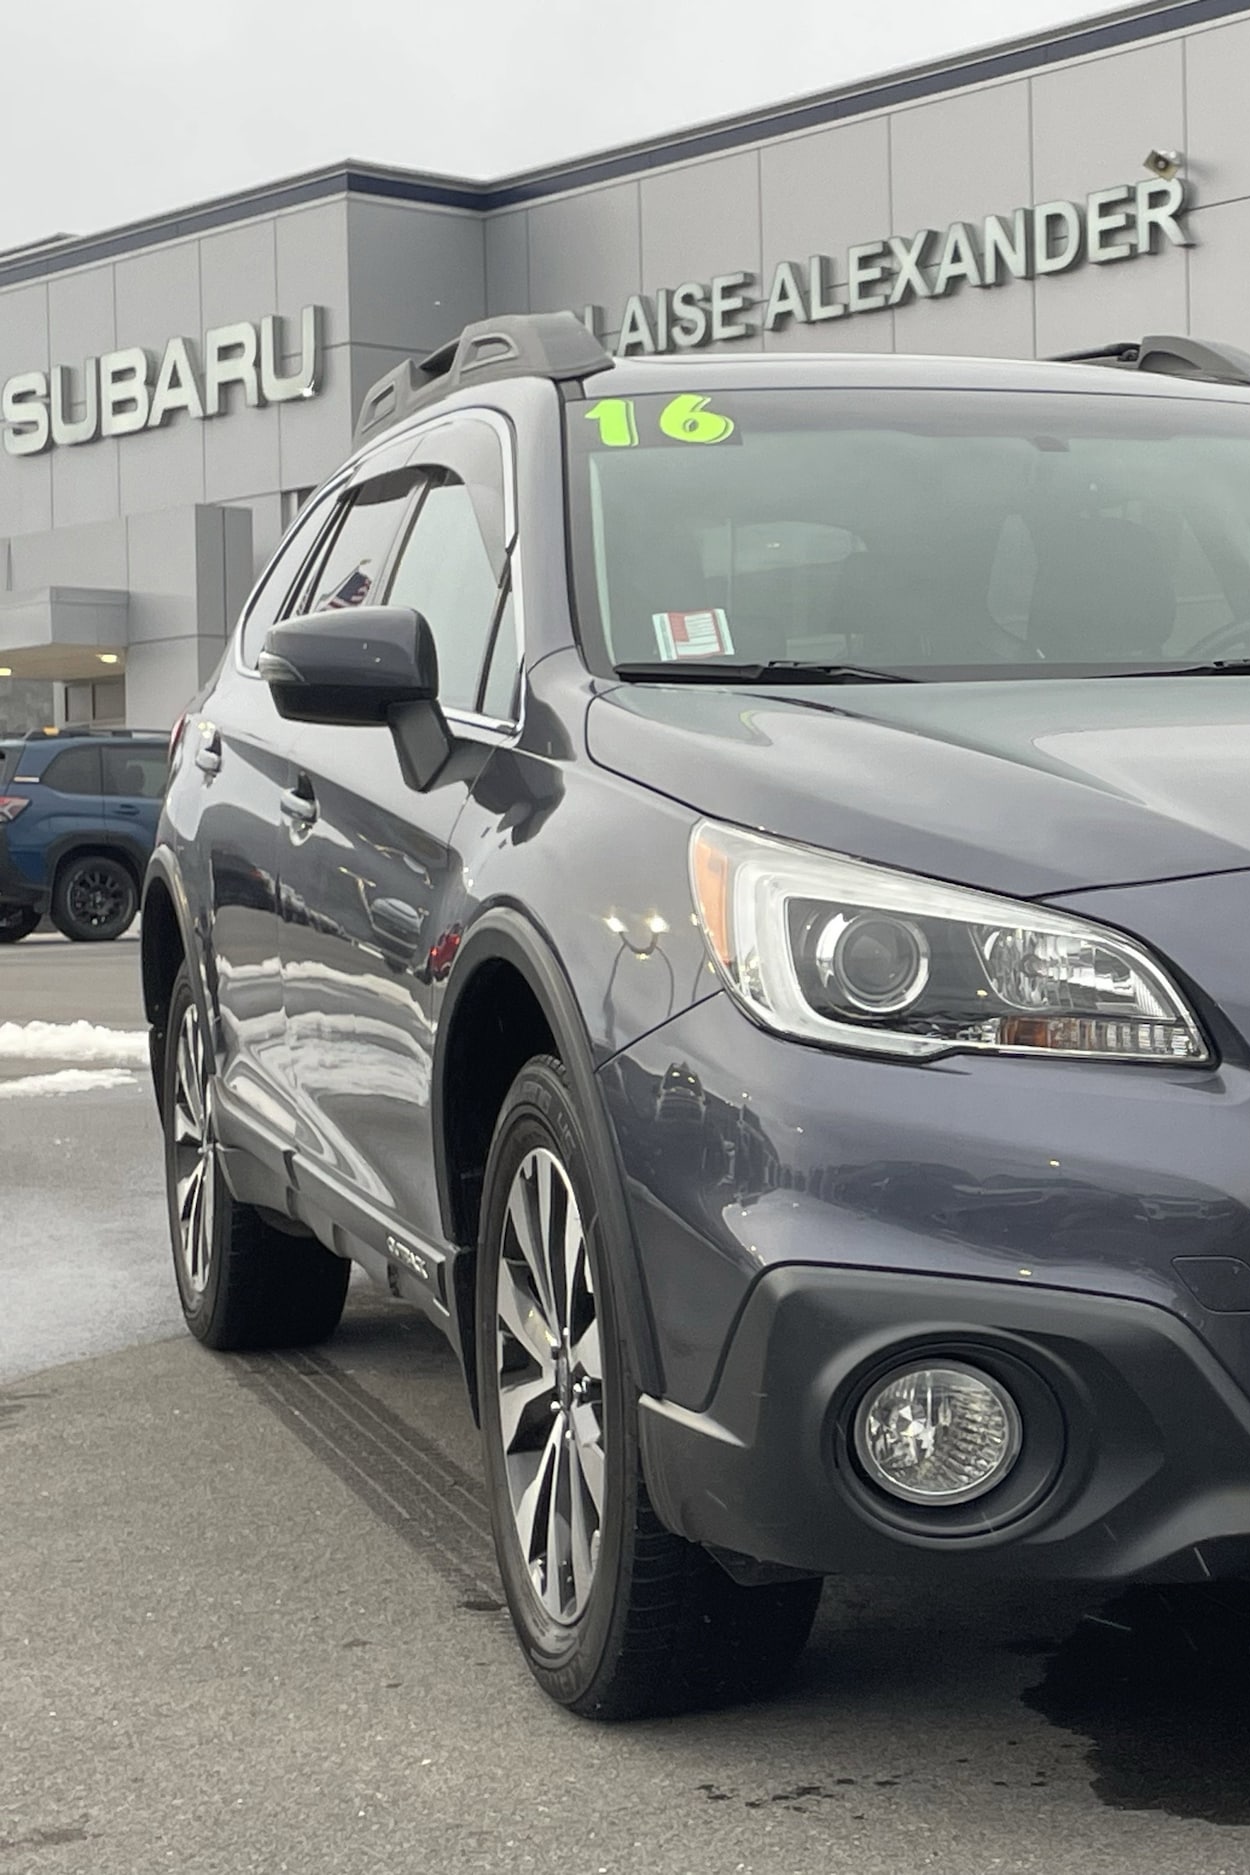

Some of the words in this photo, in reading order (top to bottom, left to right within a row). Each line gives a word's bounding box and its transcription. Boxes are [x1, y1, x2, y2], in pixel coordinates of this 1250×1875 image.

[764, 177, 1196, 331] ALEXANDER
[2, 304, 322, 456] SUBARU
[584, 393, 735, 447] 16
